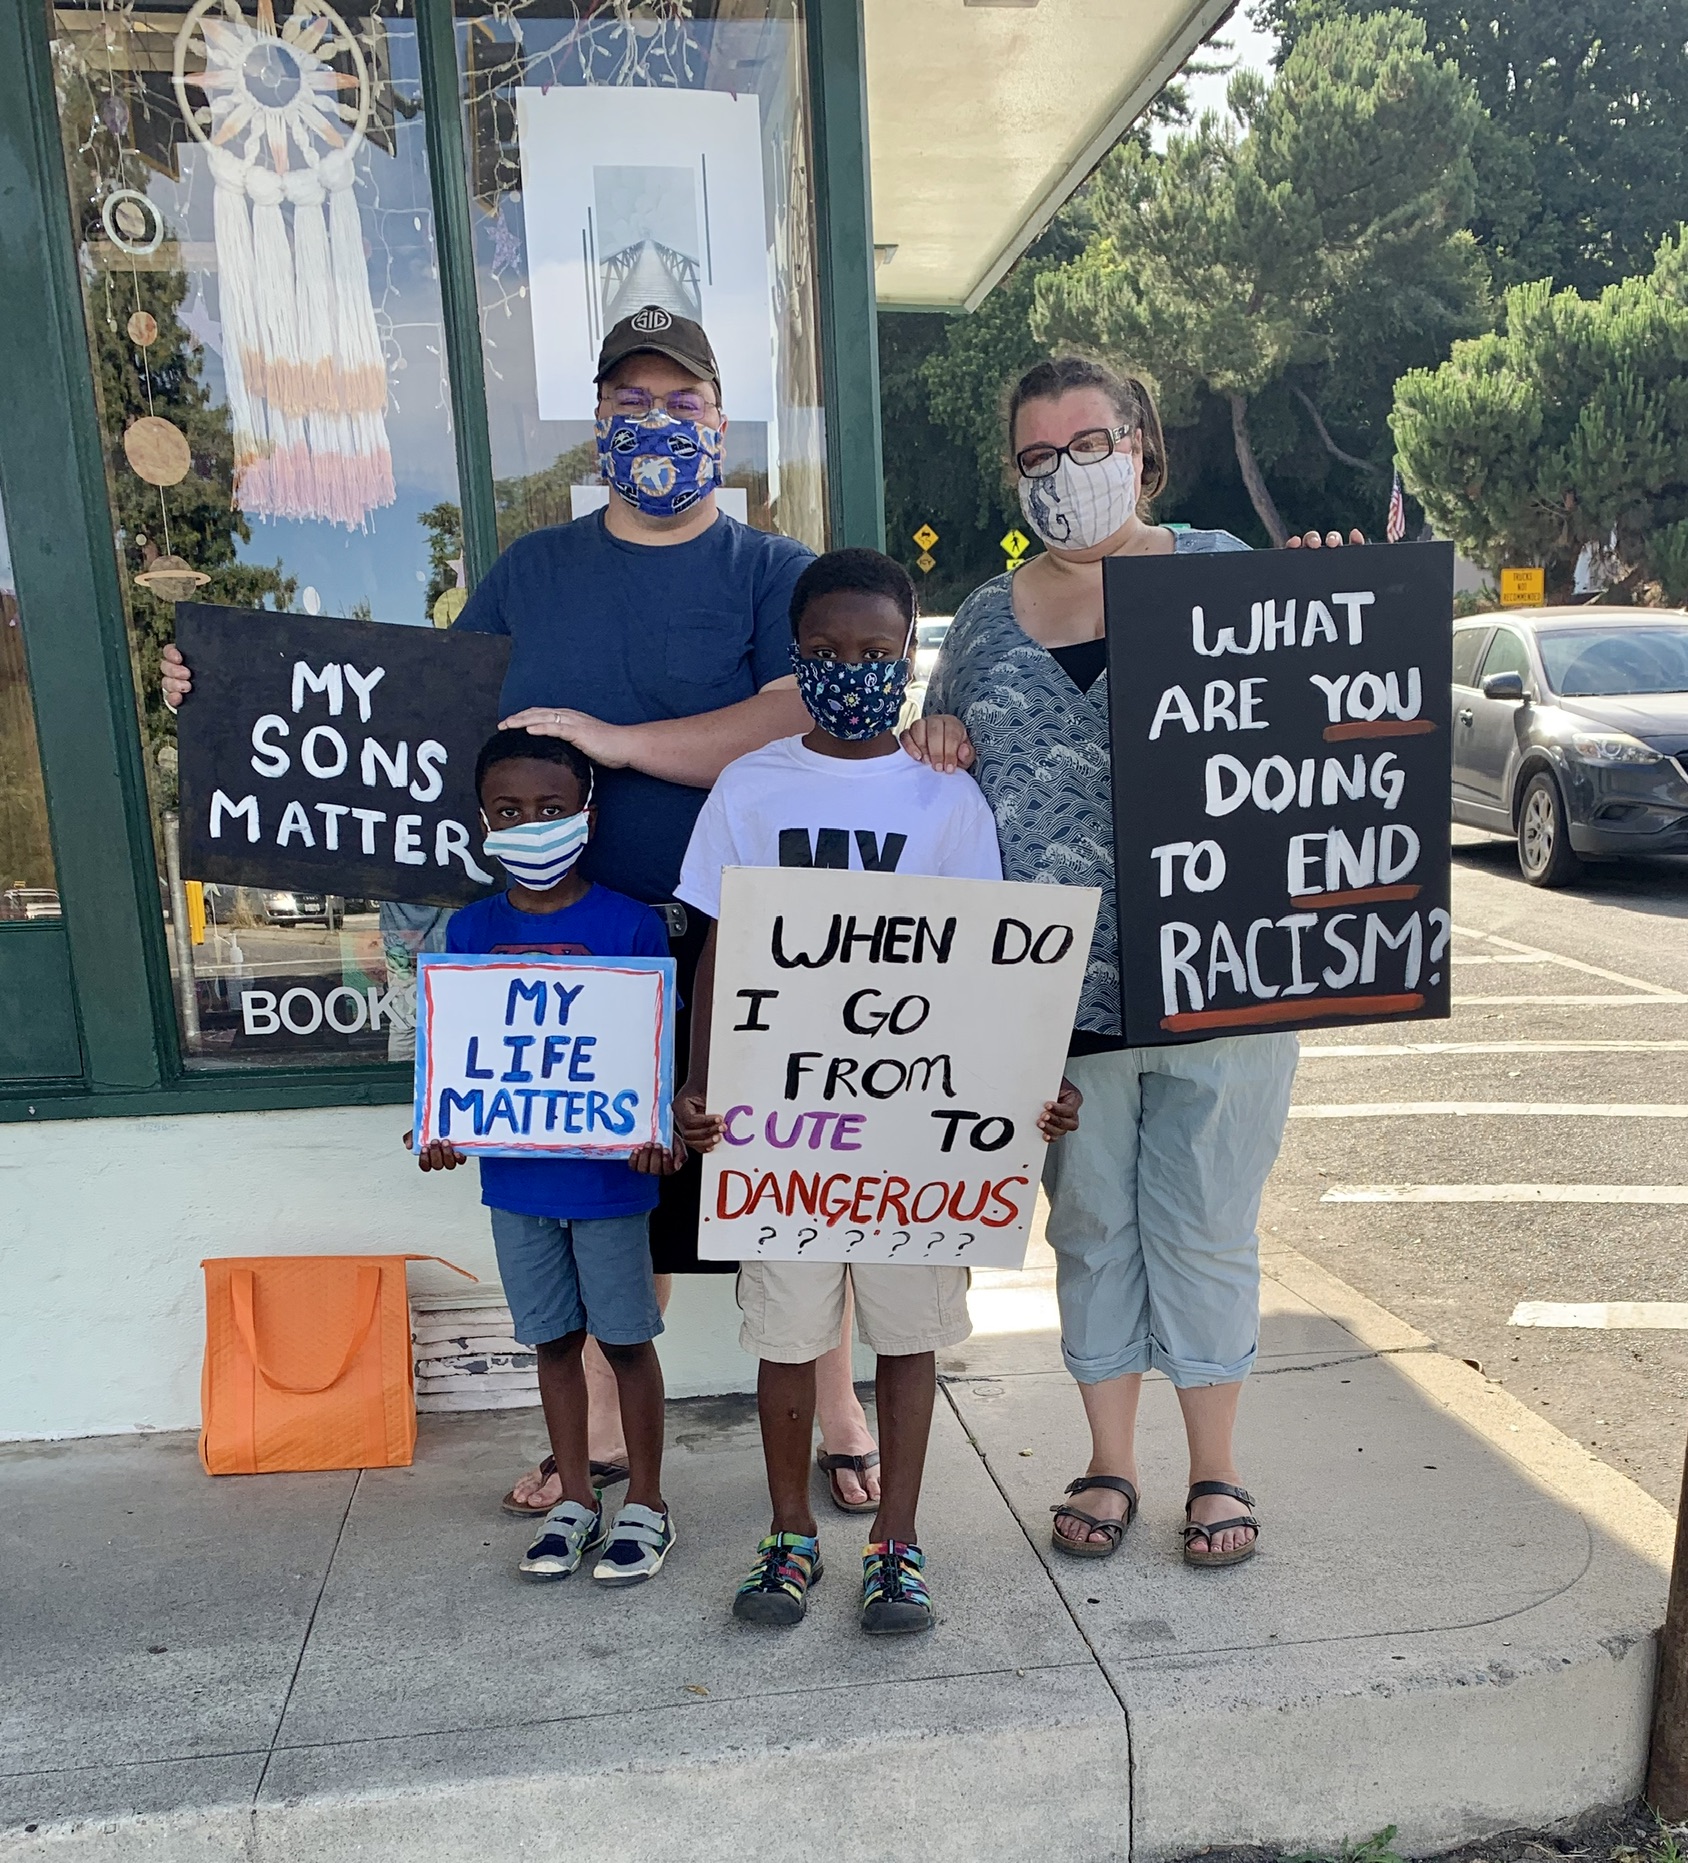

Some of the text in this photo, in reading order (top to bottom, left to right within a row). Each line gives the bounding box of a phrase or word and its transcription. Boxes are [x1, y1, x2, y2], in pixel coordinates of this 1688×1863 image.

[636, 310, 667, 329] SIG
[1192, 591, 1376, 657] WHAT
[292, 662, 384, 723] MY
[1148, 667, 1423, 740] ARE YOU
[251, 715, 448, 802] SONS
[1205, 752, 1406, 817] DOING
[210, 790, 495, 884] MATTER
[1150, 825, 1422, 898] TO END
[771, 914, 1073, 968] WHEN DO
[1160, 908, 1451, 1015] RACISM?
[505, 978, 584, 1026] MY
[733, 989, 930, 1039] I GO
[466, 1036, 596, 1082] LIFE
[784, 1053, 957, 1100] FROM
[438, 1089, 638, 1137] MATTERS
[722, 1105, 1014, 1152] CUTE TO
[717, 1170, 1028, 1228] DANGEROUS
